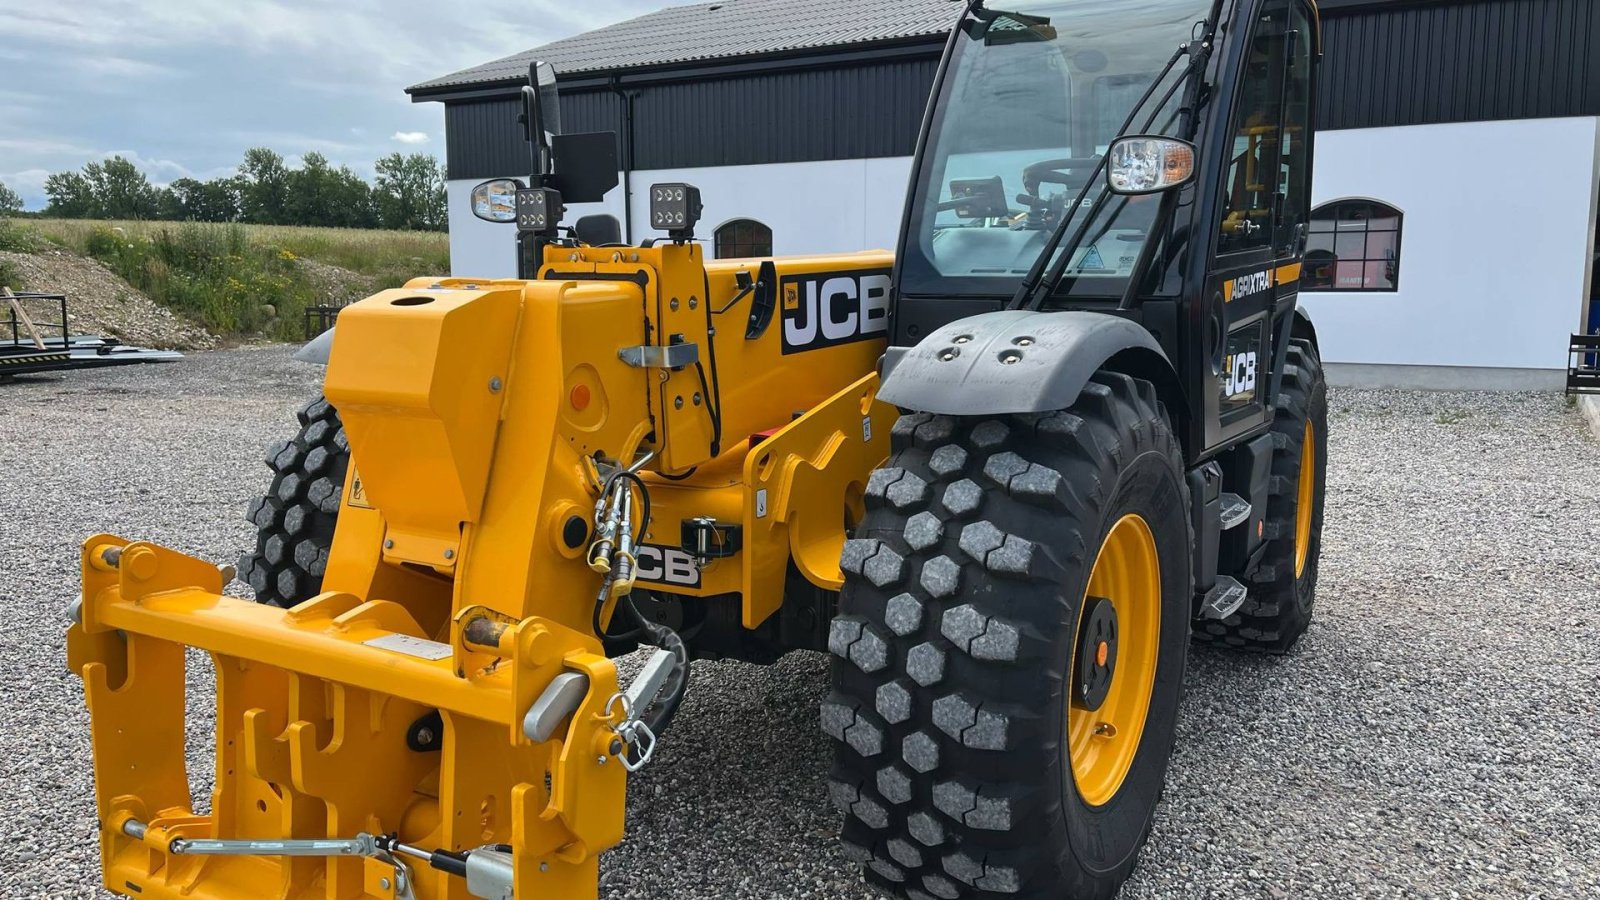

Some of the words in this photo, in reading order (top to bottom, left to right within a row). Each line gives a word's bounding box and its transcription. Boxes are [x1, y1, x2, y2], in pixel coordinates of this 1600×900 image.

[1231, 270, 1270, 300] AGRIXTRA
[784, 274, 891, 346] JCB
[1225, 351, 1256, 397] JCB
[636, 545, 699, 585] CB
